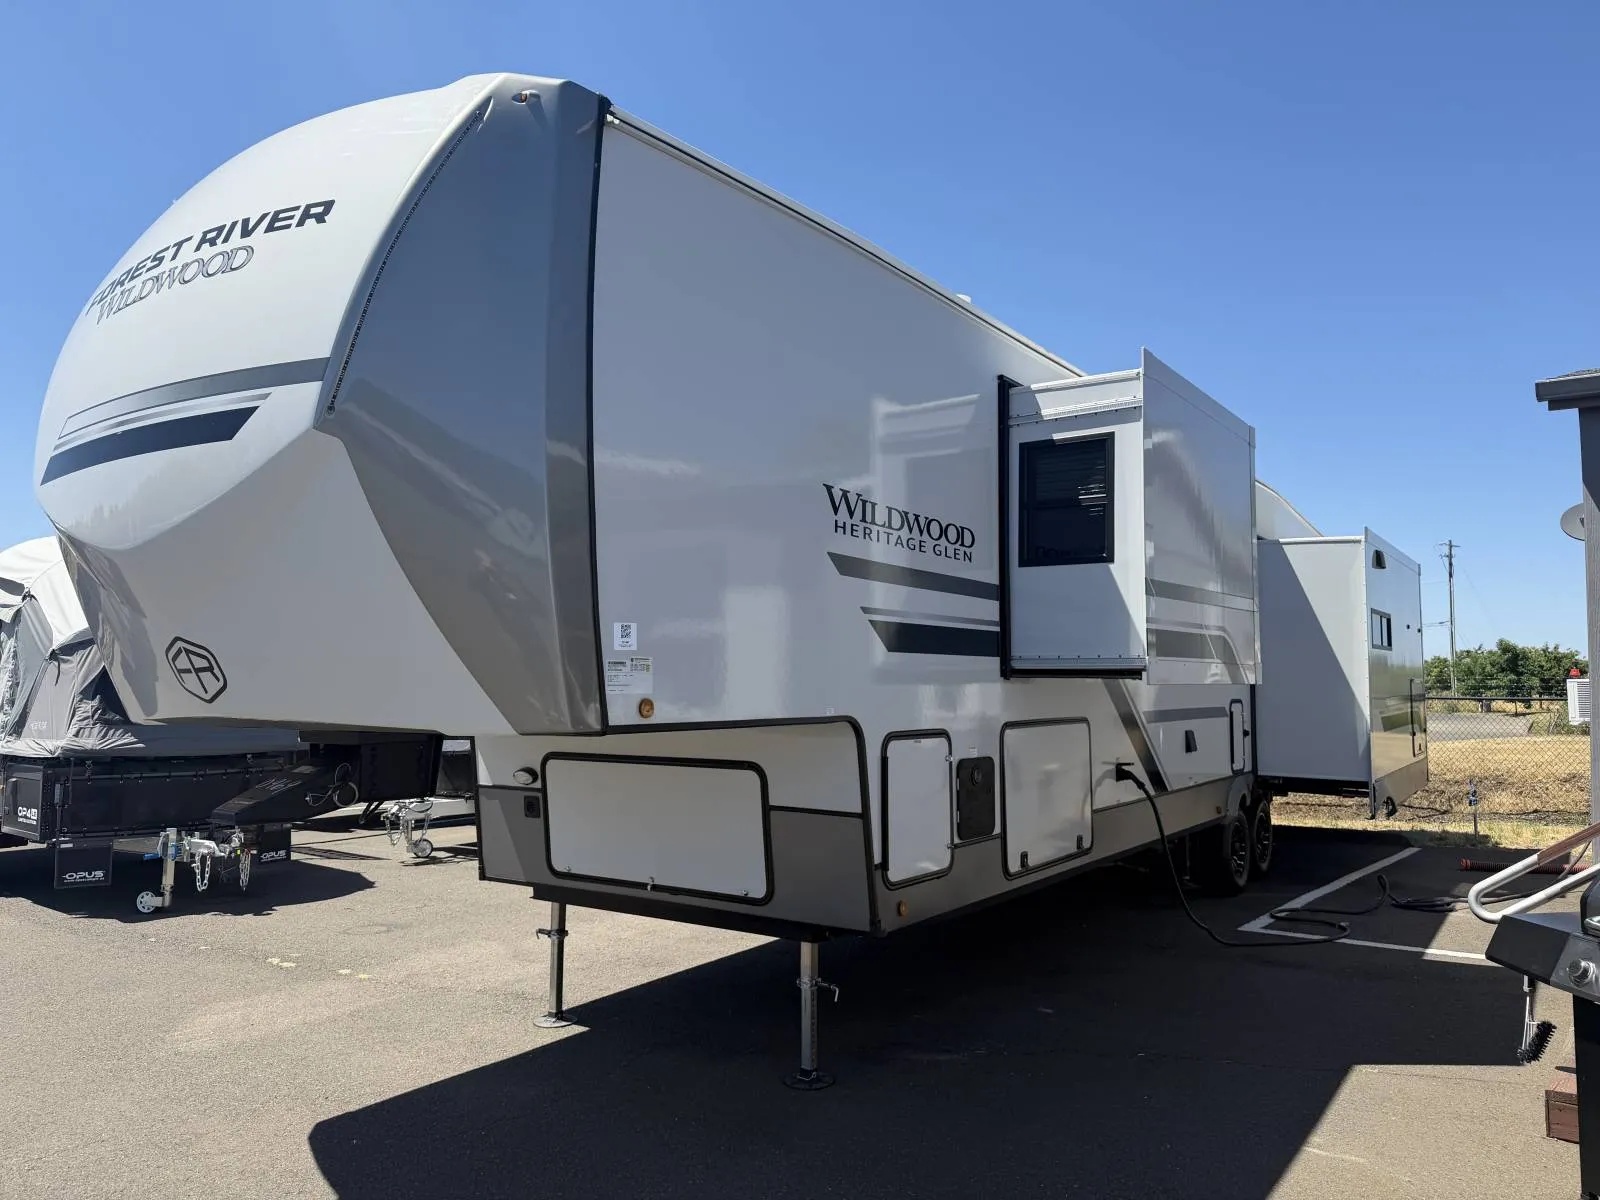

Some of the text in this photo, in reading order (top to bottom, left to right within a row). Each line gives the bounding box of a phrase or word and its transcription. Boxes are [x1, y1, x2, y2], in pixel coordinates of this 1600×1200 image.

[85, 199, 336, 317] FOREST RIVER
[97, 245, 255, 325] WILDWOOD
[822, 483, 976, 549] WILDWOOD
[834, 519, 973, 563] HERITAGE GLEN
[64, 870, 105, 880] OPUS
